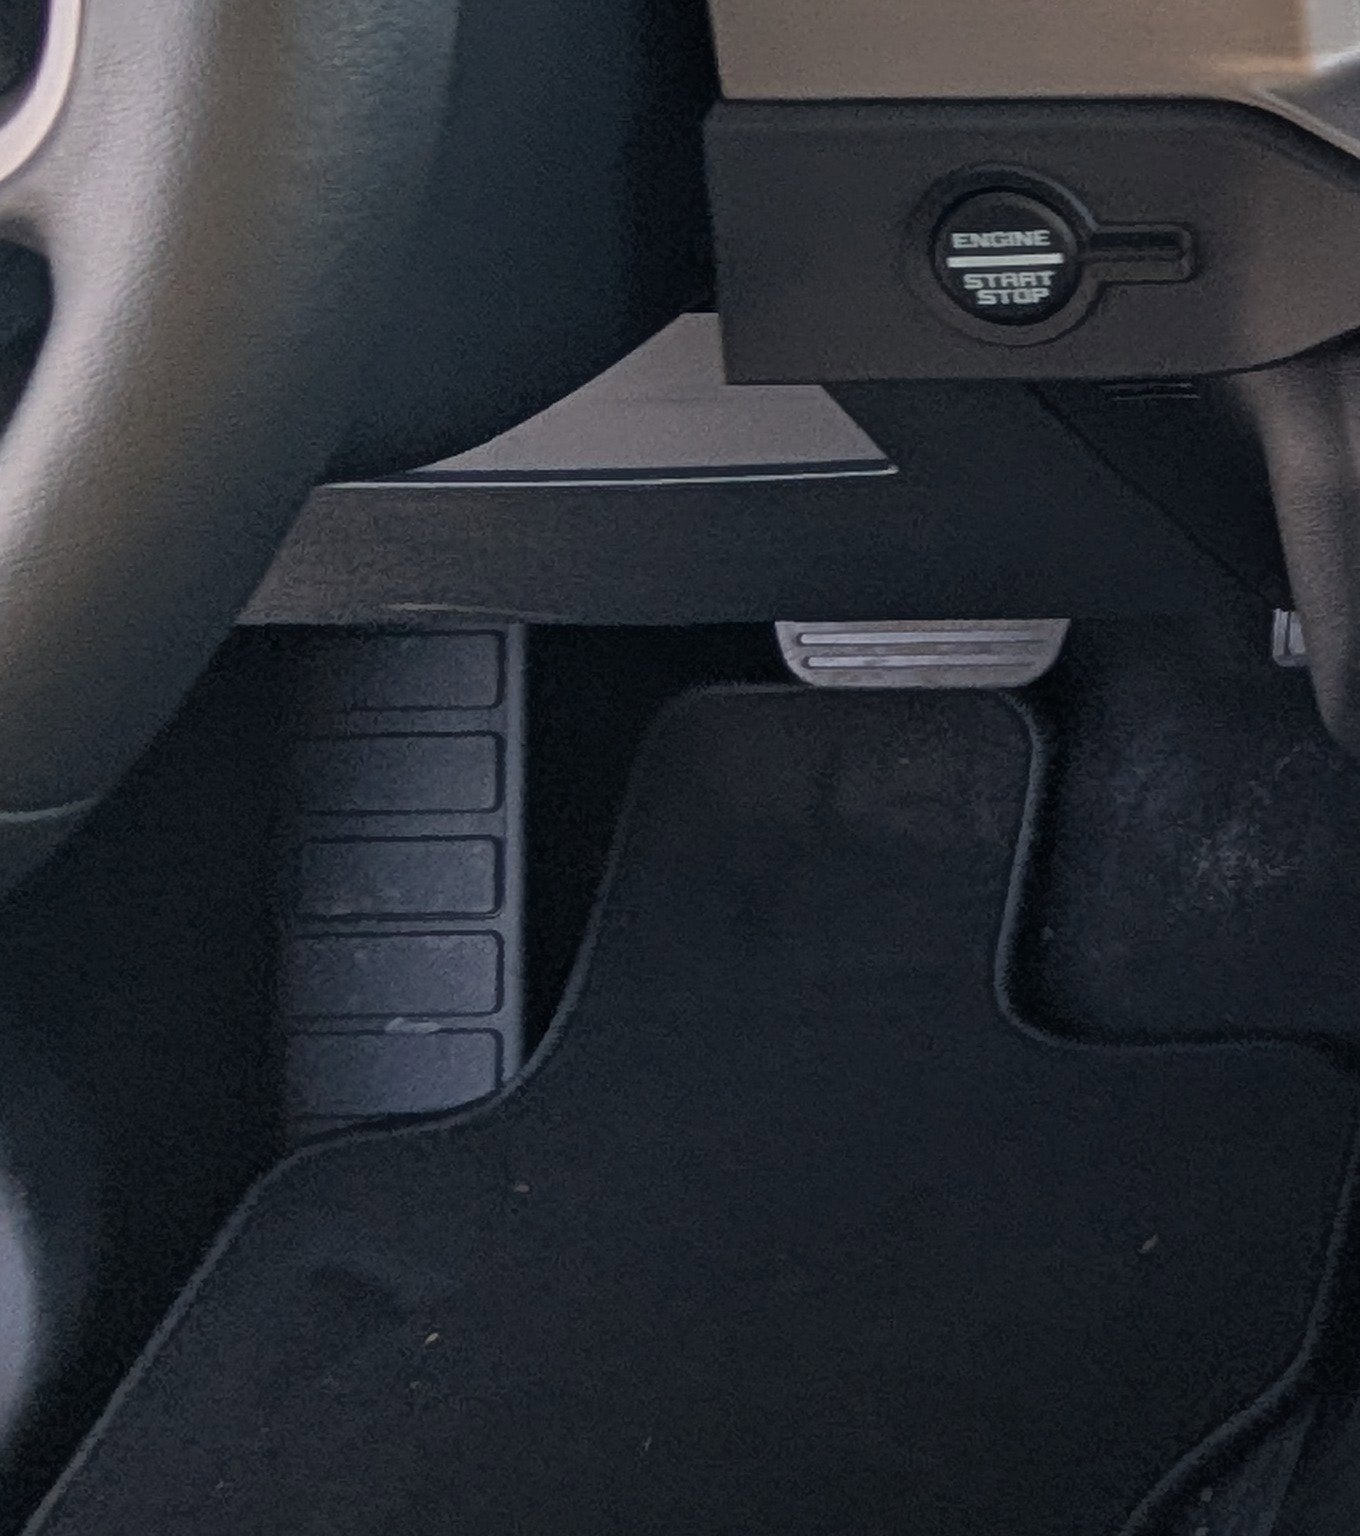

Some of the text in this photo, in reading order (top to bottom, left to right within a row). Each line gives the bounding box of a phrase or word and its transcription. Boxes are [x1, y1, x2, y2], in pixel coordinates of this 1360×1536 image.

[951, 229, 1051, 249] ENGINE
[963, 271, 1056, 289] START
[976, 288, 1050, 305] STOP
